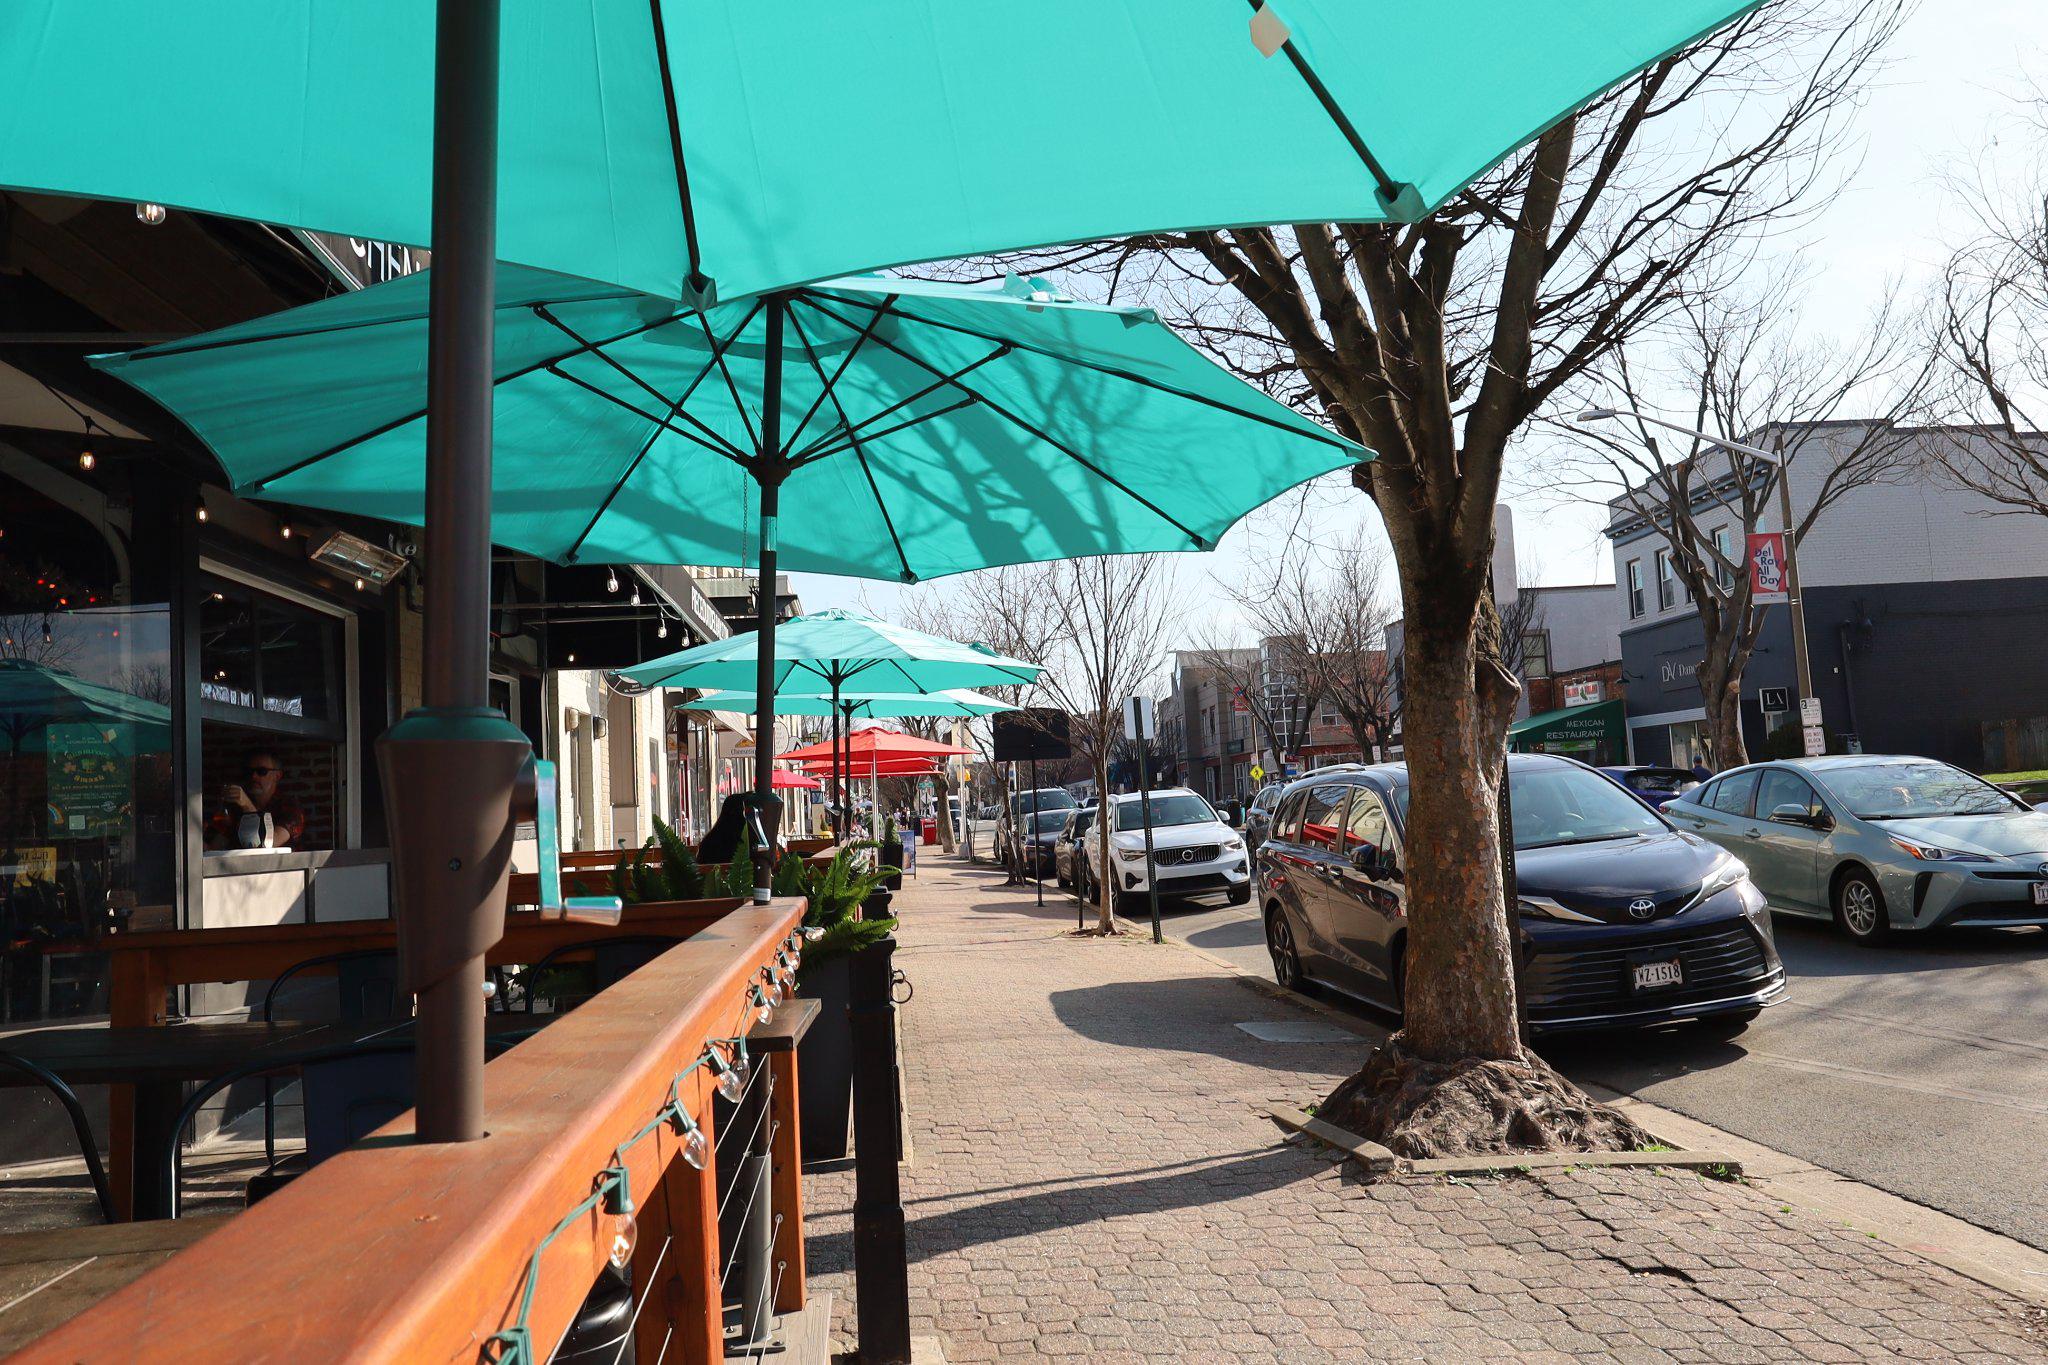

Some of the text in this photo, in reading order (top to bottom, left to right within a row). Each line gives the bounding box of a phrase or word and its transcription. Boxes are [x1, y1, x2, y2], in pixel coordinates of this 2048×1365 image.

[1755, 547, 1771, 557] Del
[1761, 557, 1779, 567] Ray
[1757, 566, 1770, 576] All
[1760, 576, 1779, 587] Day
[1566, 719, 1605, 728] MEXICAN
[1546, 729, 1605, 740] RESTAURANT
[1632, 964, 1680, 983] TWZ-1518
